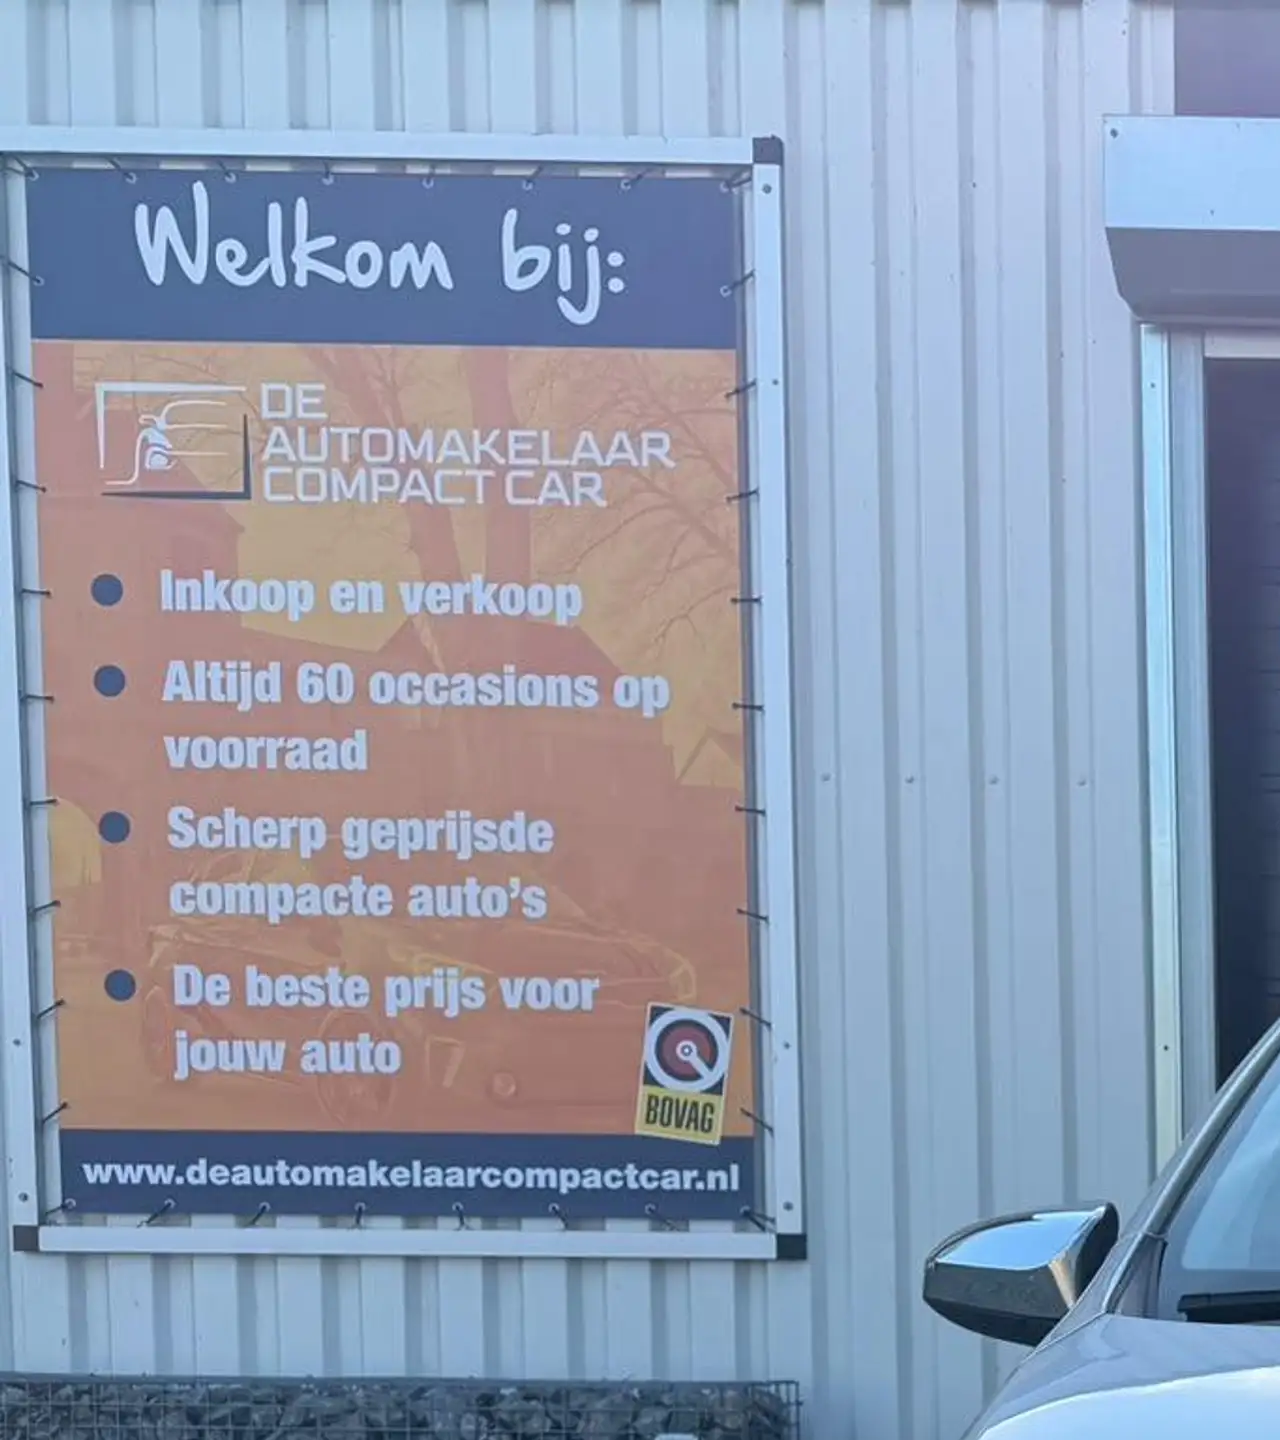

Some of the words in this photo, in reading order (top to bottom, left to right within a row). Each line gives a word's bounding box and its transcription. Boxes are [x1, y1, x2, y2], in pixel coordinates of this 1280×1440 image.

[135, 180, 453, 290] Welkom
[503, 208, 624, 324] bij:
[261, 383, 328, 420] DE
[263, 429, 676, 469] AUTOMAKELAAR
[264, 467, 495, 505] COMPACT
[506, 470, 607, 508] CAR
[161, 570, 315, 621] Inkoop
[329, 579, 385, 615] en
[400, 574, 583, 626] verkoop
[162, 660, 282, 712] Altijd
[297, 664, 354, 705] 60
[369, 667, 599, 708] occasions
[613, 676, 670, 717] op
[164, 730, 368, 771] voorraad
[167, 806, 327, 858] Scherp
[342, 809, 554, 860] geprijsde
[170, 875, 393, 924] compacte
[407, 878, 547, 919] auto's
[173, 964, 230, 1006] De
[245, 965, 370, 1009] beste
[384, 968, 486, 1017] prijs
[500, 977, 599, 1011] voor
[174, 1031, 285, 1080] jouw
[301, 1036, 401, 1074] auto
[645, 1093, 715, 1133] BOVAG
[82, 1158, 740, 1194] www.deautomakelaarcompactcar.nl
